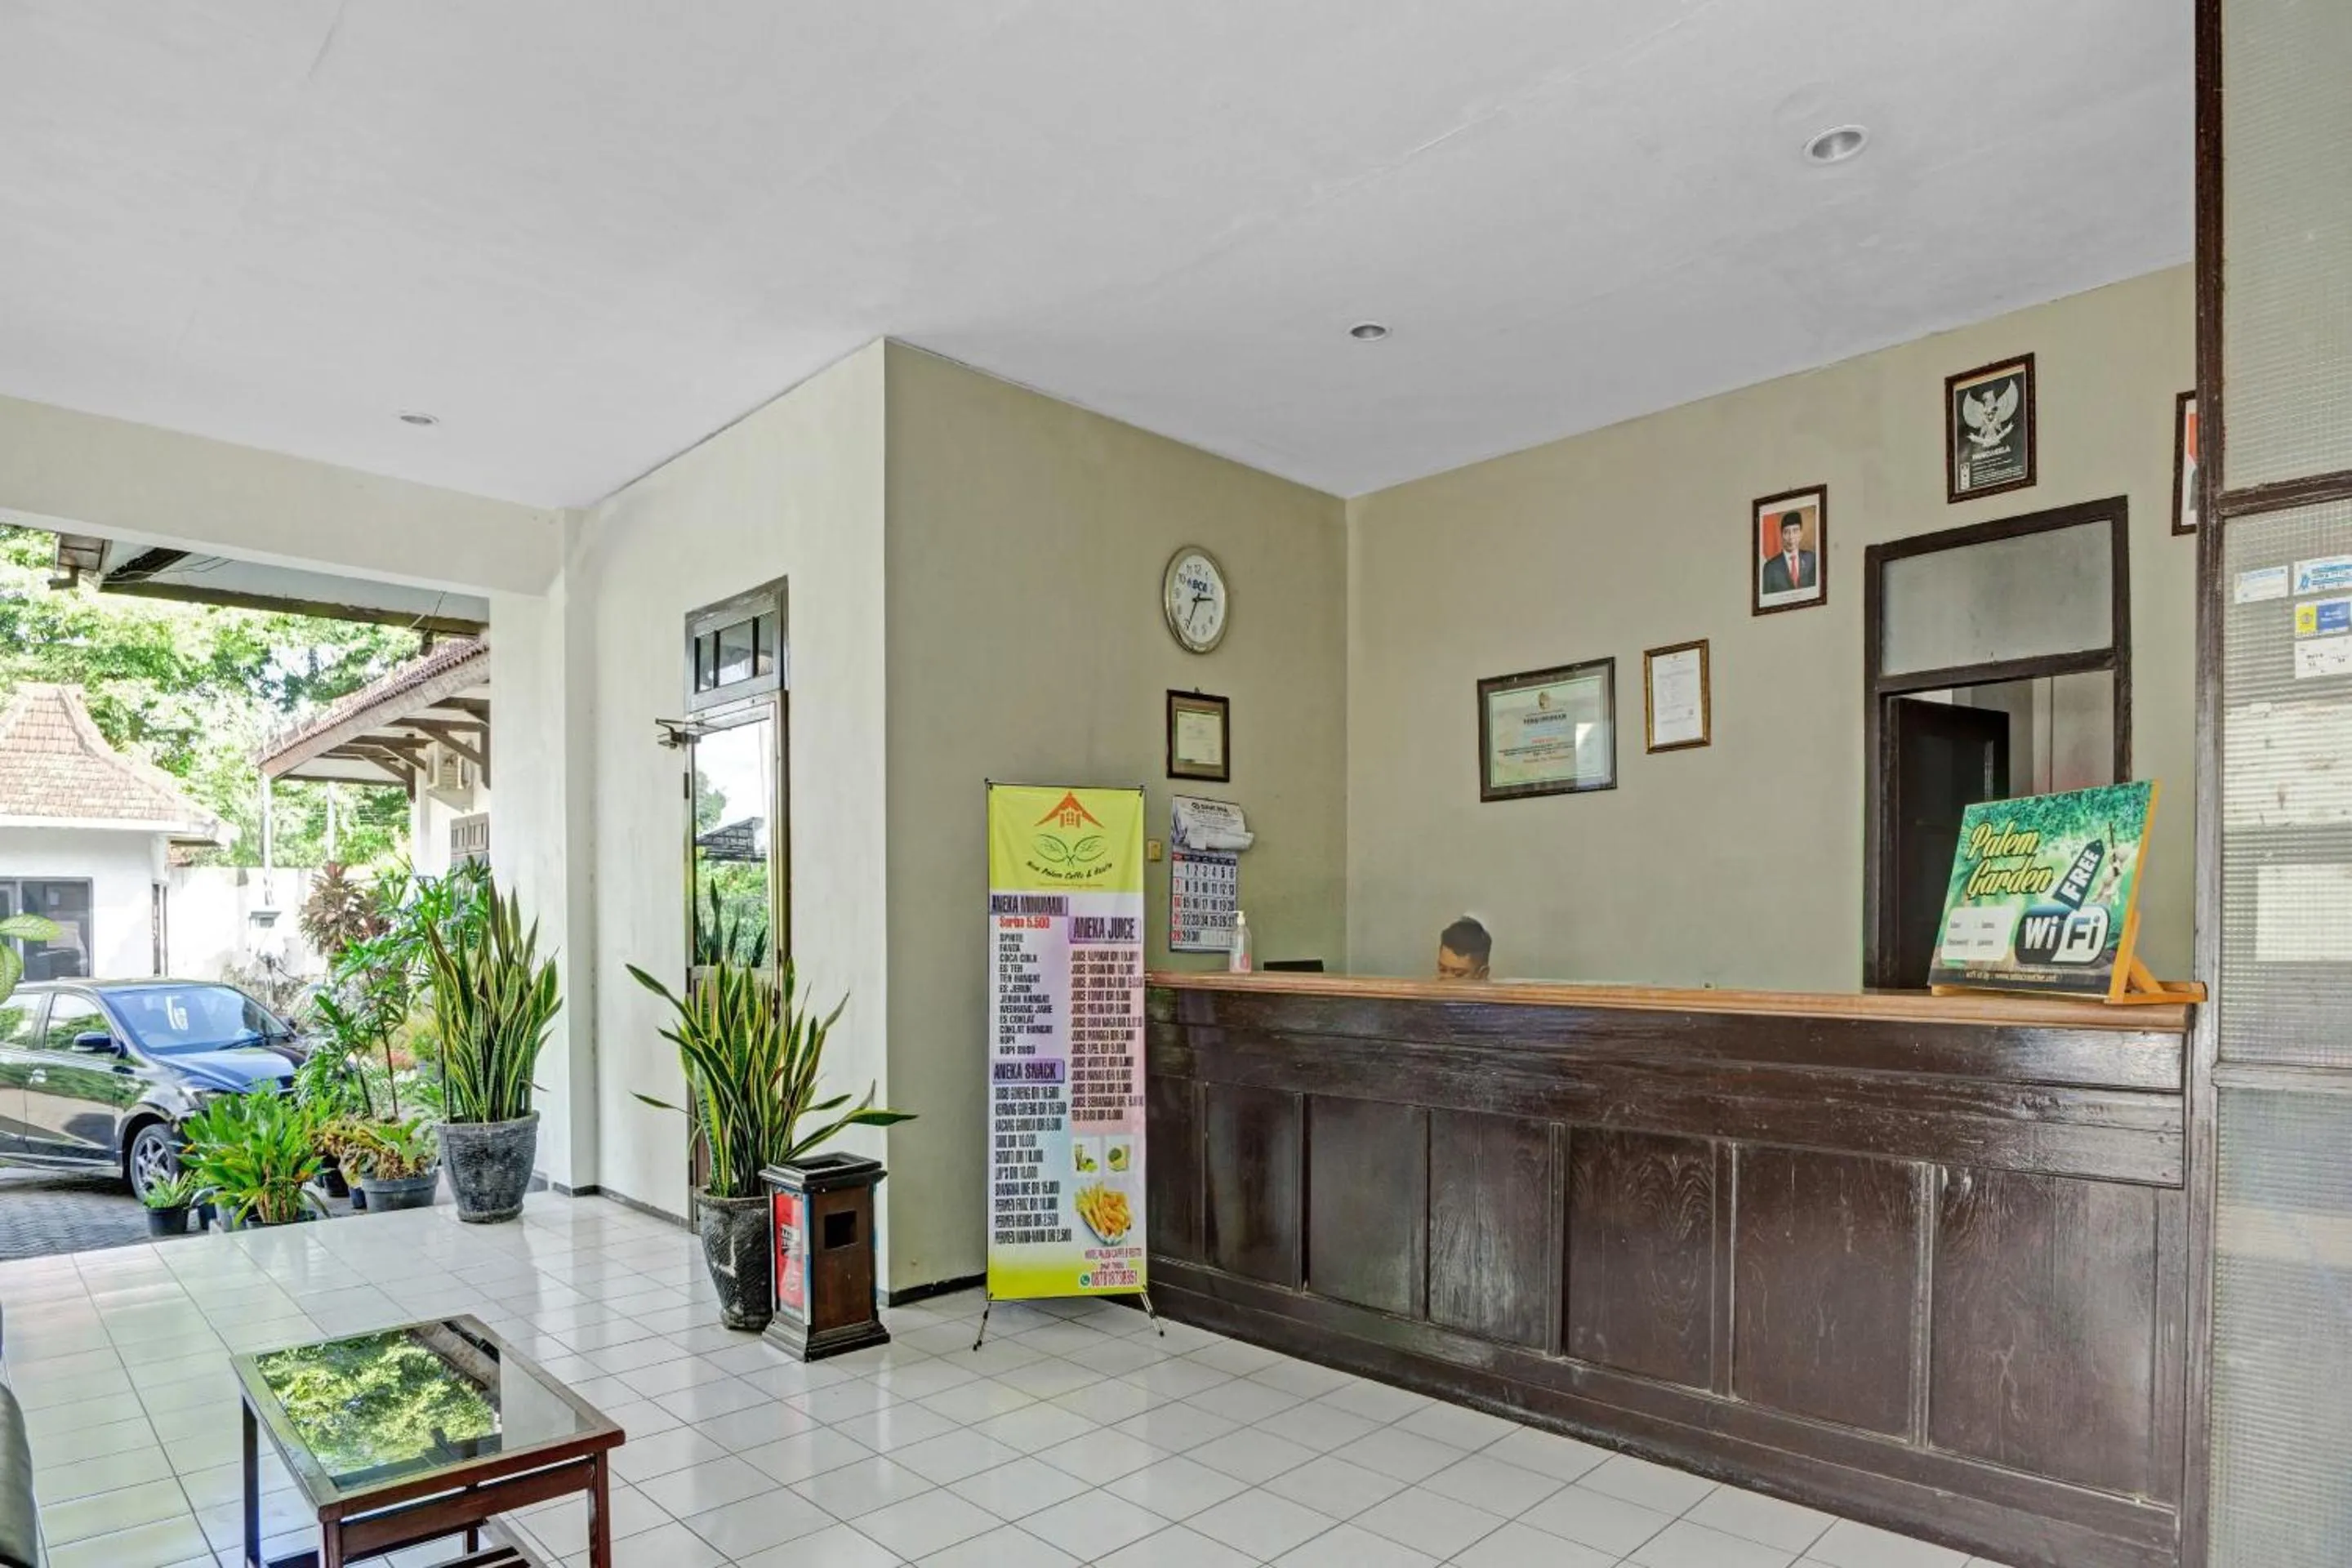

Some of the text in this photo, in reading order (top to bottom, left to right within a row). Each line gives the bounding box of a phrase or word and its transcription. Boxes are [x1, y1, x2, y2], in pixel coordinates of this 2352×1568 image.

[1965, 818, 2040, 860] Palem
[1967, 854, 2054, 900] Garden
[2060, 849, 2100, 902] FREE
[1108, 917, 1134, 939] JUICE
